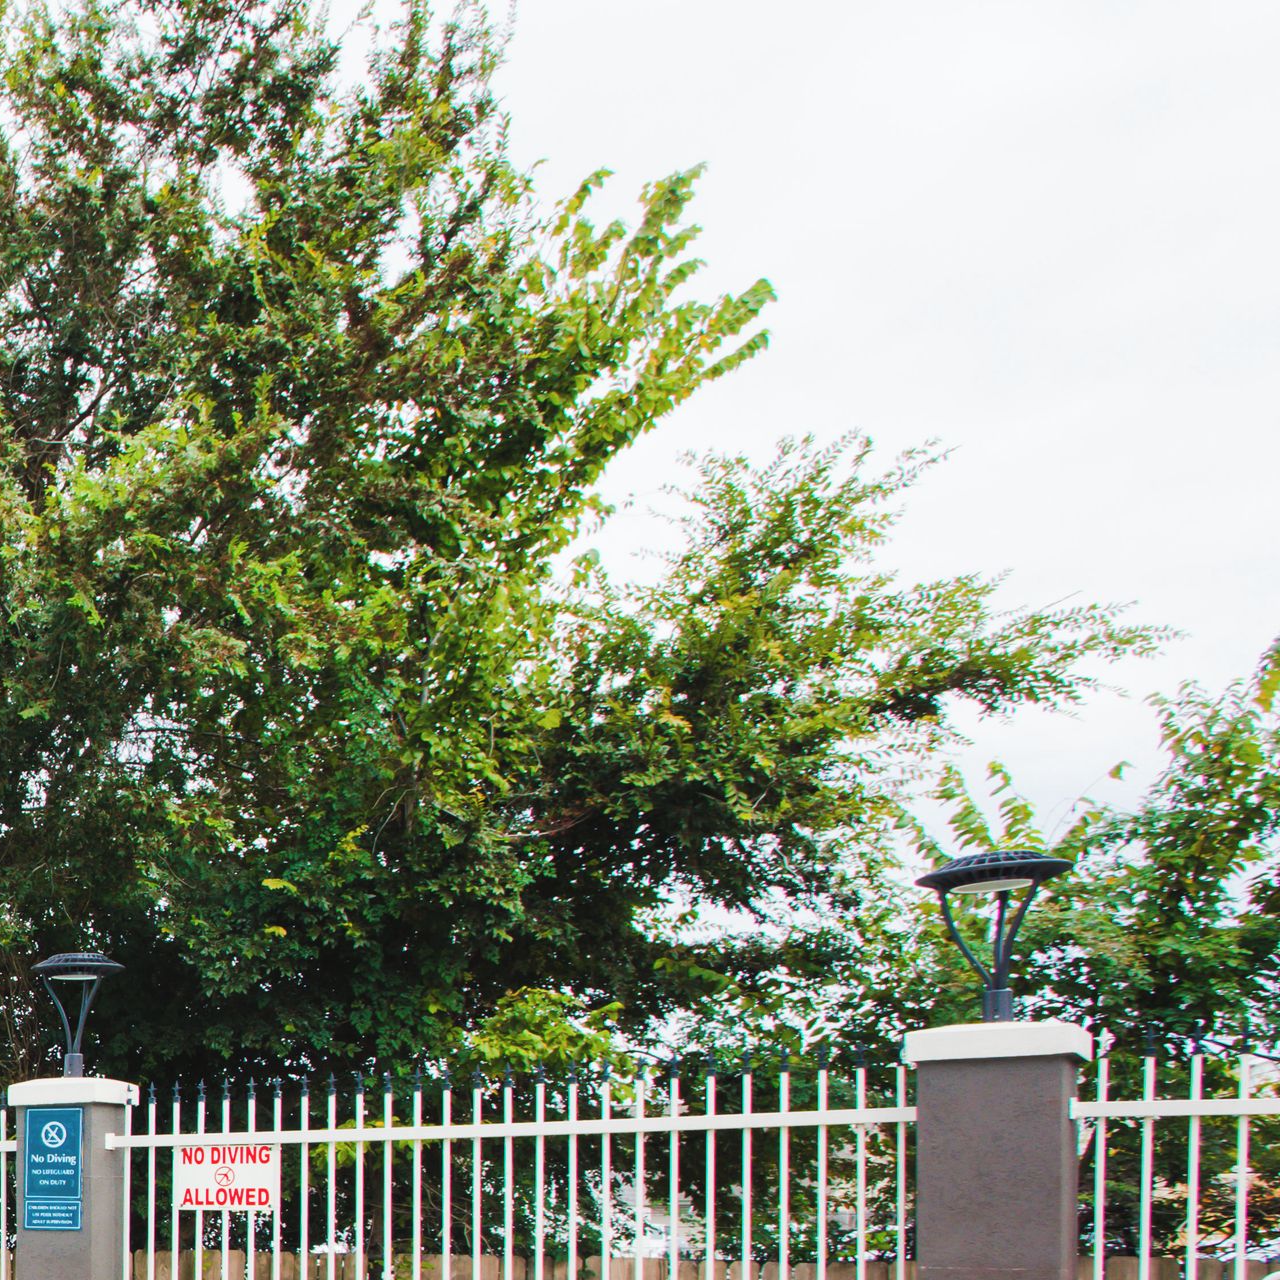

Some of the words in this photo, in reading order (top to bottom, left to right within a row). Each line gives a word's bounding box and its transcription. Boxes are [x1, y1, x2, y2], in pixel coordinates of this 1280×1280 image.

[31, 1154, 44, 1163] No
[47, 1153, 76, 1165] Diving
[183, 1147, 205, 1164] NO
[211, 1146, 270, 1164] DIVING
[182, 1188, 270, 1205] ALLOWED
